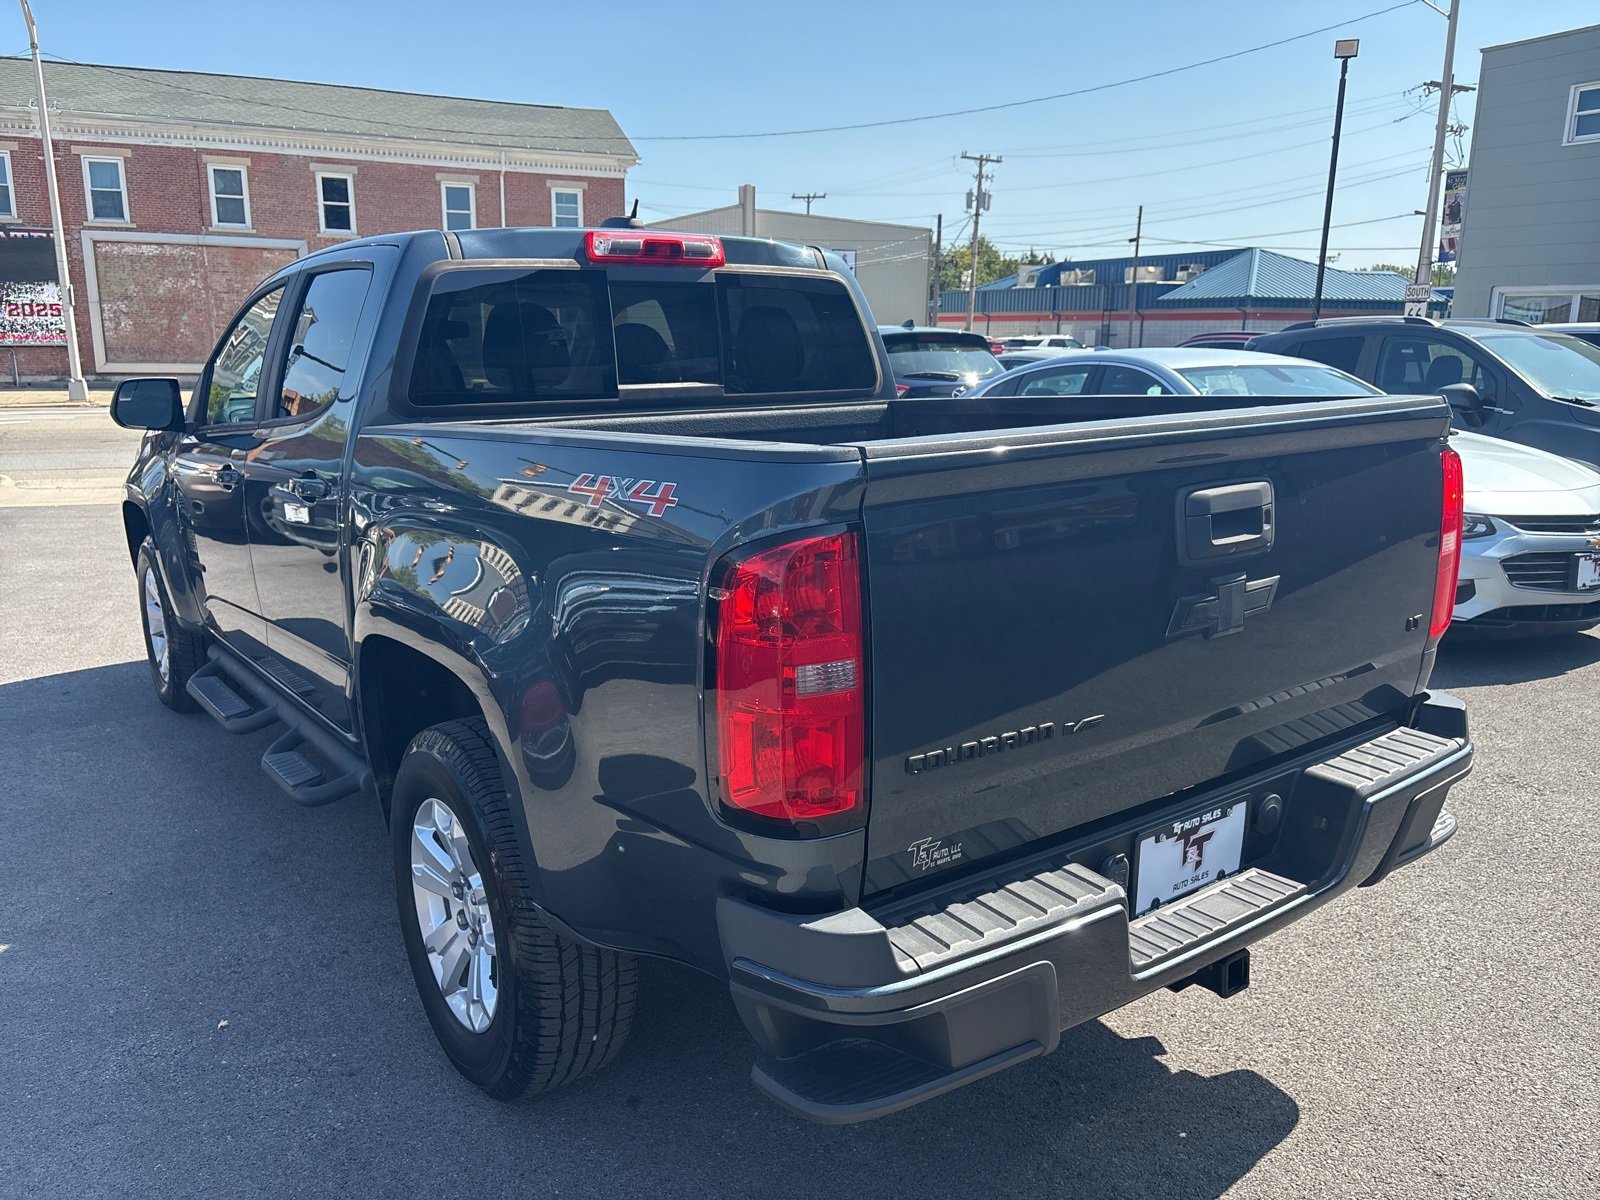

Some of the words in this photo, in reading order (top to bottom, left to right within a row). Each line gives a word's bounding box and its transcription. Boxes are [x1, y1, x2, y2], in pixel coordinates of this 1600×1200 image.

[1406, 286, 1429, 298] SOUTH
[8, 303, 63, 317] 2025
[1405, 613, 1423, 632] LT
[904, 722, 1056, 776] COLORADO
[1183, 817, 1200, 831] AUTO
[1202, 809, 1221, 823] SALES
[951, 843, 962, 853] LLC
[1172, 879, 1188, 893] AUTO
[1191, 871, 1209, 884] SALES
